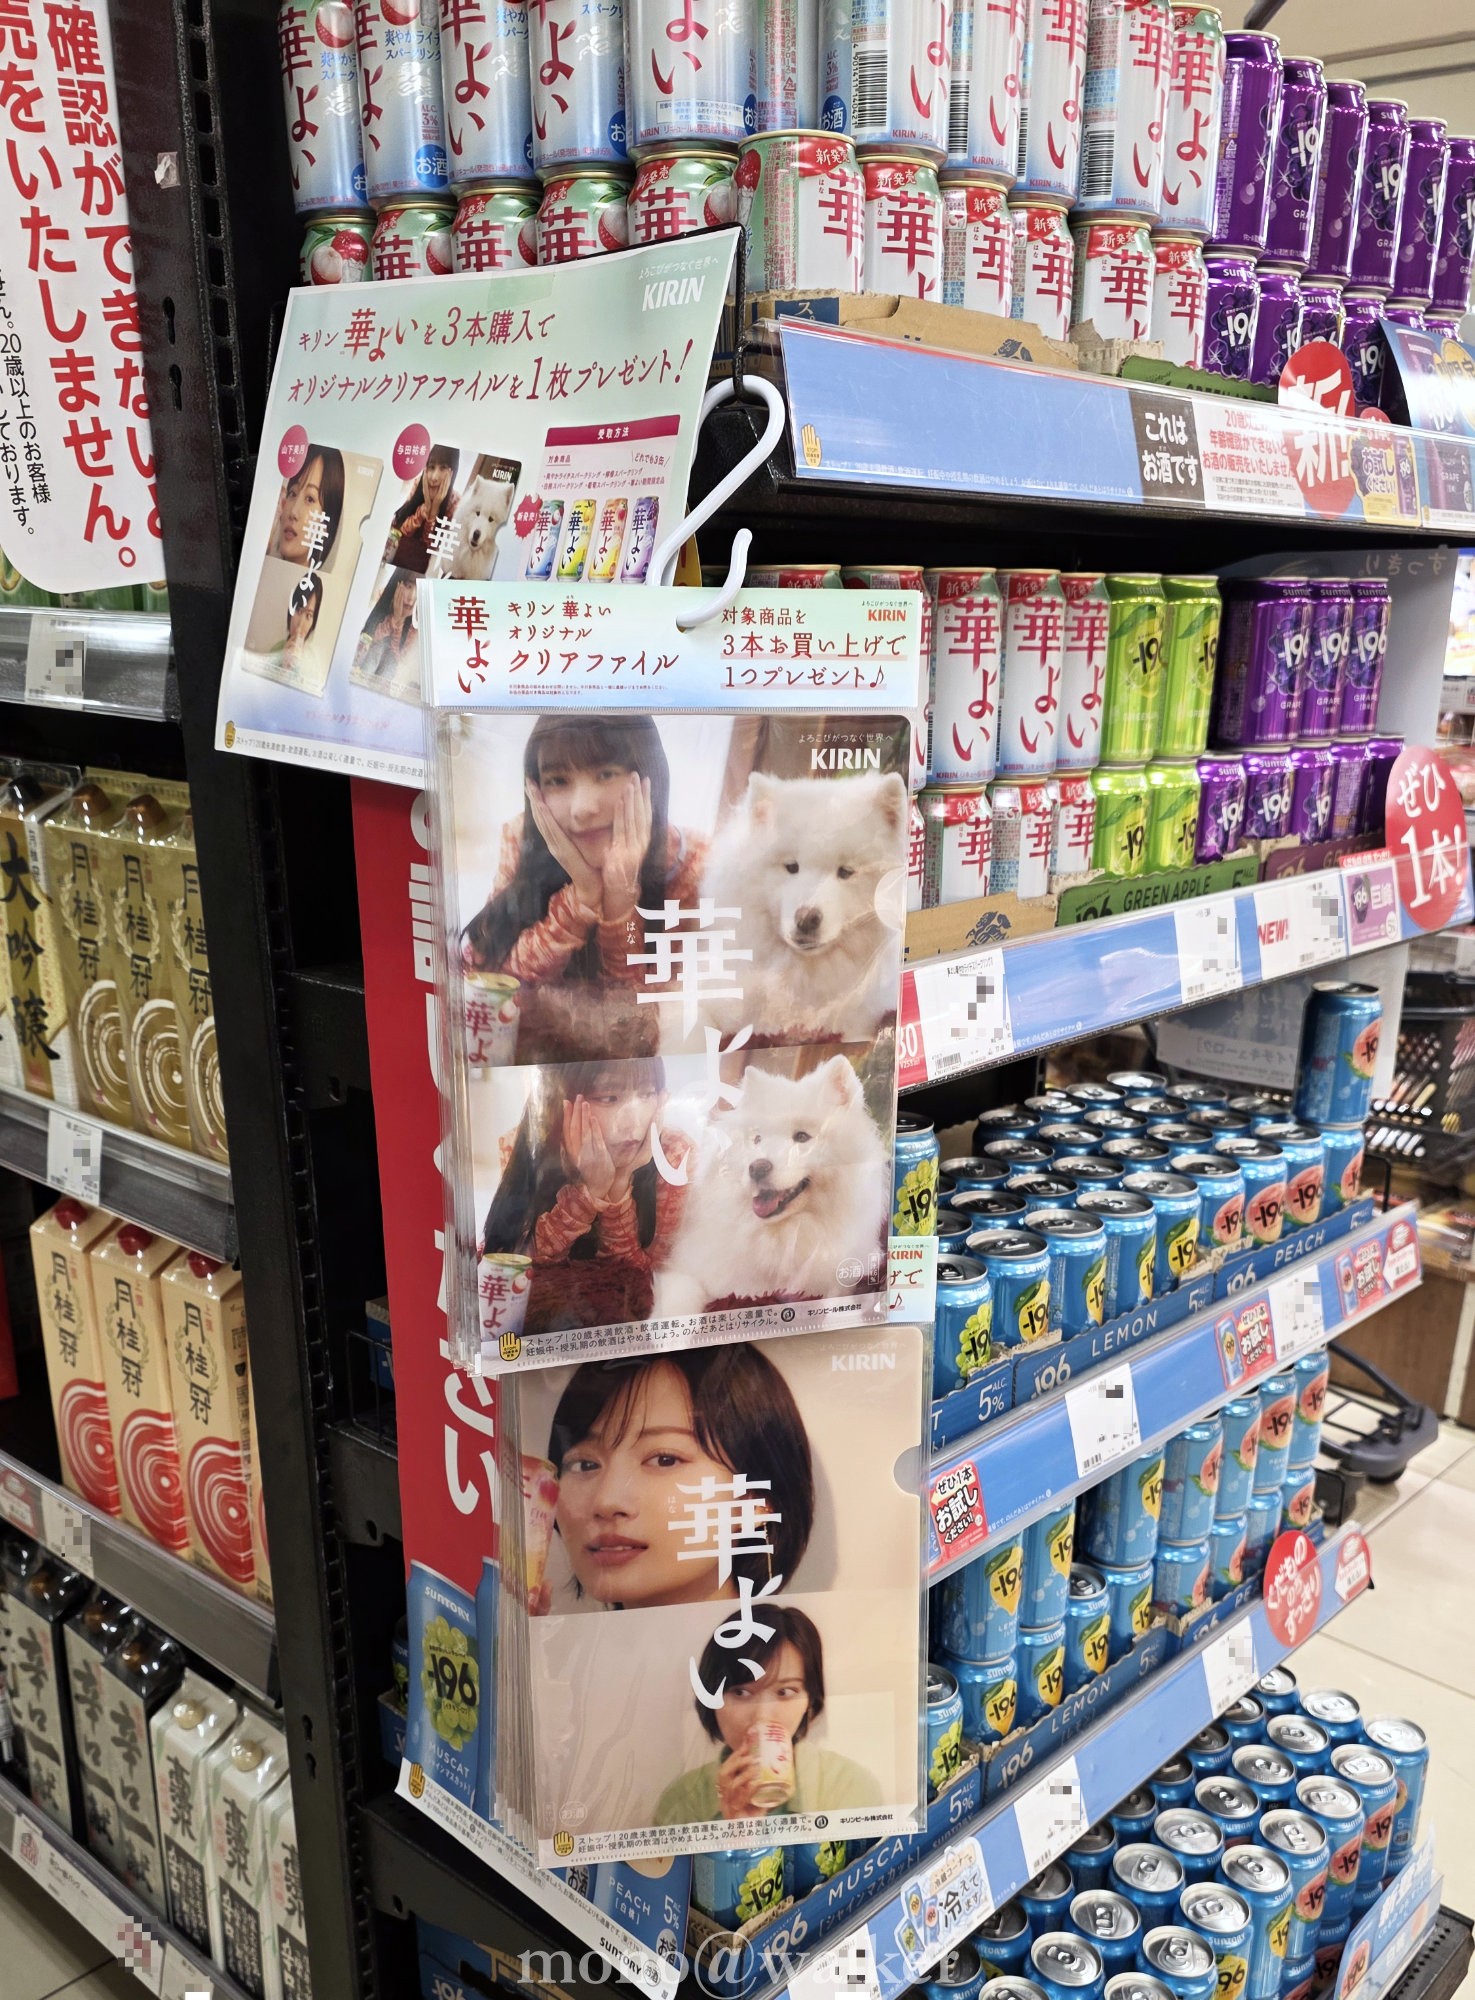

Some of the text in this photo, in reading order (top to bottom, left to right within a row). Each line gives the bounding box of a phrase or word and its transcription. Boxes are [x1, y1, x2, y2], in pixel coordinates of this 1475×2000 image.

[1162, 32, 1216, 206] 華よい
[416, 155, 448, 176] お酒
[877, 168, 917, 188] 新発売
[877, 190, 937, 276] 華
[642, 275, 706, 312] KIRIN
[1101, 248, 1151, 322] 華
[287, 338, 694, 405] オリジナルクリアファイルを1枚プレゼント!
[597, 426, 630, 441] 受取方法
[1145, 412, 1188, 445] これは
[1141, 449, 1198, 487] お酒です
[289, 510, 331, 618] 華よい
[945, 580, 980, 596] 新発売
[508, 600, 611, 620] キリン 華よい
[721, 606, 807, 627] 対象商品を
[868, 609, 907, 622] KIRIN
[447, 595, 491, 694] 華よい
[509, 625, 593, 643] オリジナル
[723, 631, 907, 659] 3本お買い上げで
[1351, 626, 1388, 664] -196
[508, 648, 680, 676] クリアファイル
[943, 597, 998, 762] 華よい
[1013, 597, 1065, 755] 華よい
[1065, 598, 1109, 749] 華よい
[798, 732, 895, 744] よろこびがつなぐ世界へ
[811, 747, 881, 771] KIRIN
[1257, 790, 1291, 822] -196
[1397, 759, 1447, 819] ぜひ
[1400, 822, 1466, 910] 1本!
[70, 842, 101, 981] 月桂冠
[1123, 874, 1211, 912] GREEN APPLE
[0, 832, 60, 1060] 大吟醸
[122, 854, 153, 1000] 月桂冠
[1258, 918, 1291, 947] NEW!
[1273, 1229, 1326, 1268] PEACH
[837, 1263, 862, 1280] お酒
[49, 1250, 79, 1369] 月桂冠
[807, 1302, 863, 1317] キリンビール株式会社
[113, 1276, 144, 1399] 月桂冠
[1091, 1310, 1159, 1358] LEMON
[183, 1300, 213, 1426] 月桂冠
[831, 1352, 897, 1373] KIRIN
[978, 1391, 1005, 1422] 5%
[936, 1466, 974, 1495] ぜひ1本
[935, 1484, 979, 1533] お試し
[943, 1514, 975, 1545] ください!
[424, 1585, 471, 1624] SUNTORY
[667, 1474, 783, 1711] 華よい
[427, 1653, 477, 1707] -196
[1050, 1676, 1112, 1734] LEMON
[997, 1740, 1035, 1791] -196
[839, 1814, 894, 1825] キリンビール株式会社
[949, 1780, 976, 1825] 5% ALC
[608, 1877, 652, 1916] PEACH
[599, 1936, 643, 1976] SUNTORY
